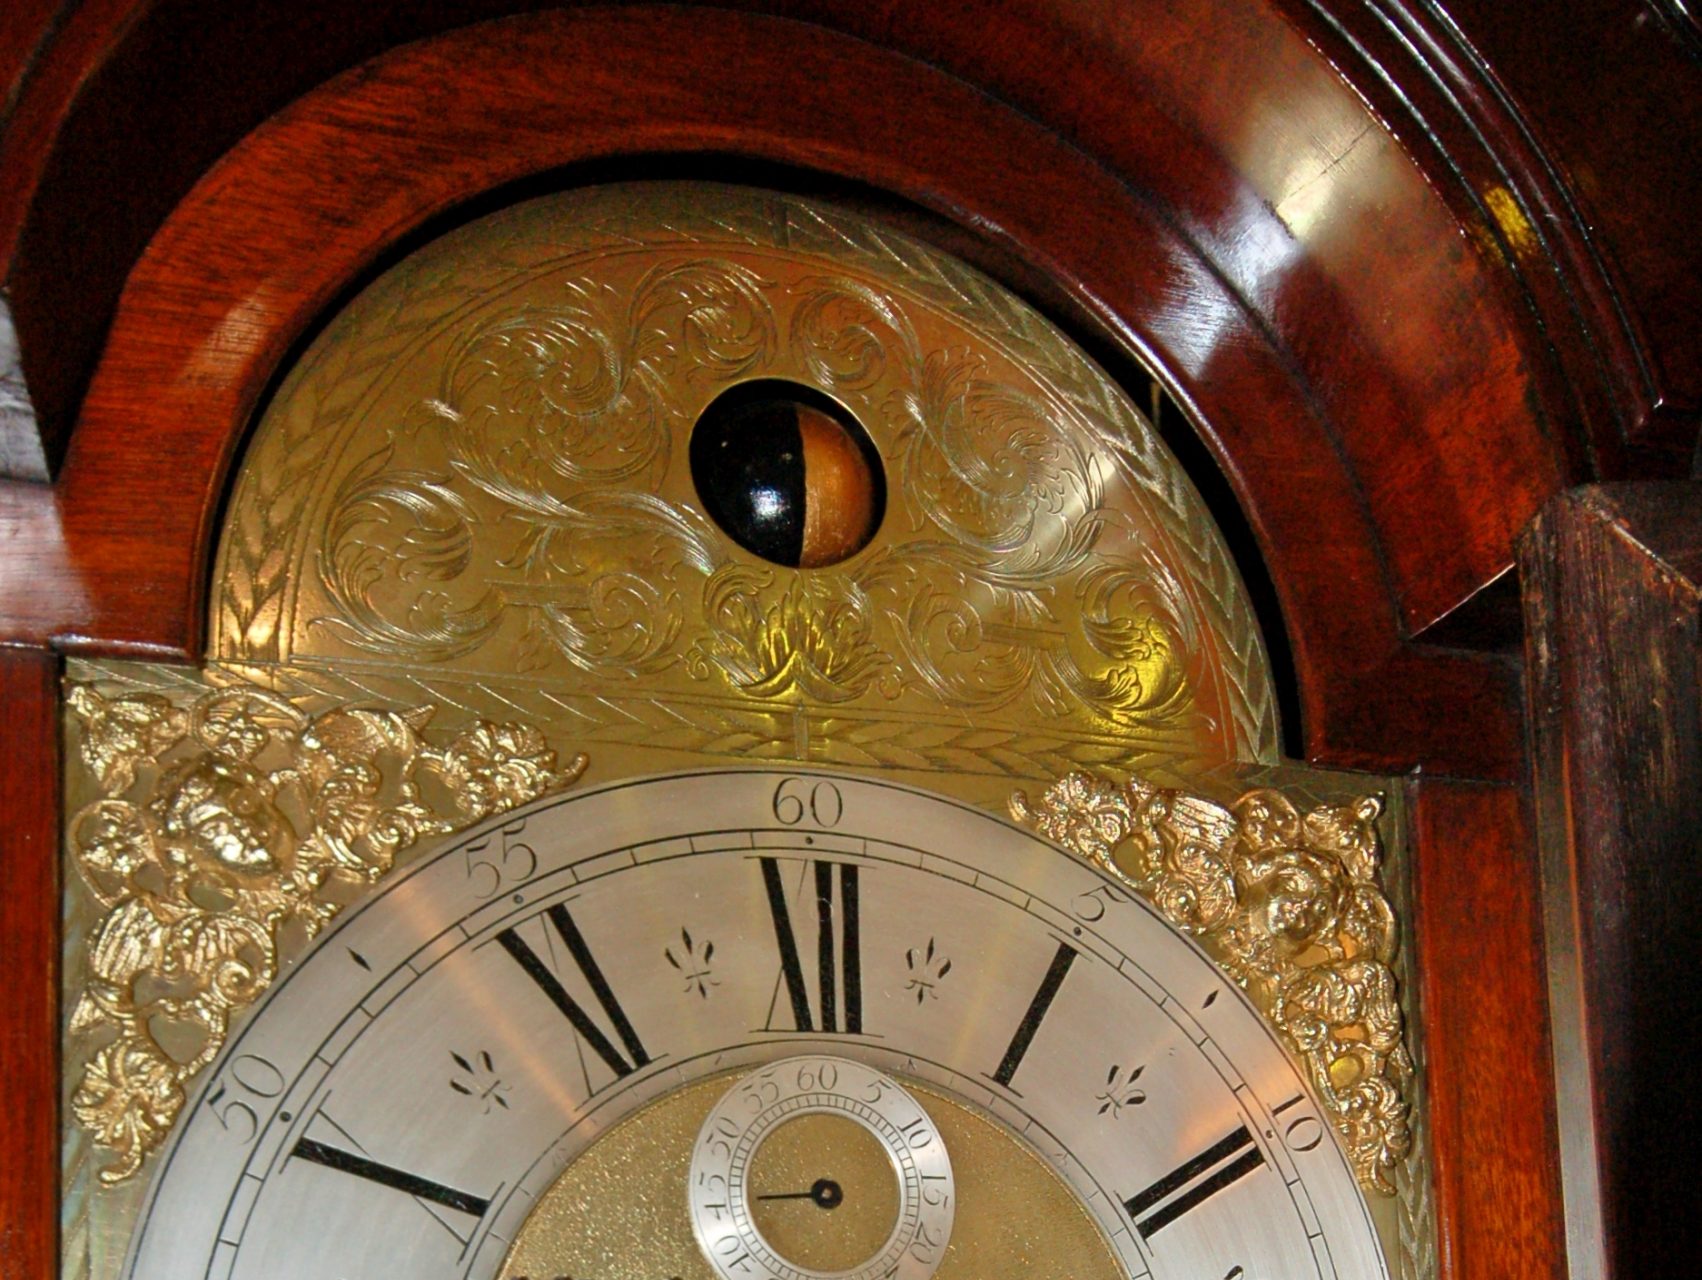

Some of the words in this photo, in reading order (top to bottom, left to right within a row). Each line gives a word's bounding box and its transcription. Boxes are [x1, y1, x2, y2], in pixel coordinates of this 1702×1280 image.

[773, 777, 844, 828] 60
[459, 823, 538, 899] 55
[1072, 884, 1130, 924] 5
[747, 855, 884, 1037] XII
[472, 894, 670, 1114] XI
[979, 931, 1092, 1097] I
[206, 1054, 285, 1144] 50
[741, 1071, 779, 1114] 55
[797, 1063, 838, 1091] 60
[861, 1079, 891, 1103] 5
[705, 1117, 740, 1161] 50
[897, 1117, 932, 1149] 10
[1267, 1093, 1324, 1154] 10
[279, 1091, 505, 1264] X
[698, 1172, 729, 1220] 45
[920, 1170, 948, 1208] 15
[1116, 1114, 1272, 1257] II
[714, 1235, 757, 1273] 40
[909, 1221, 942, 1265] 20
